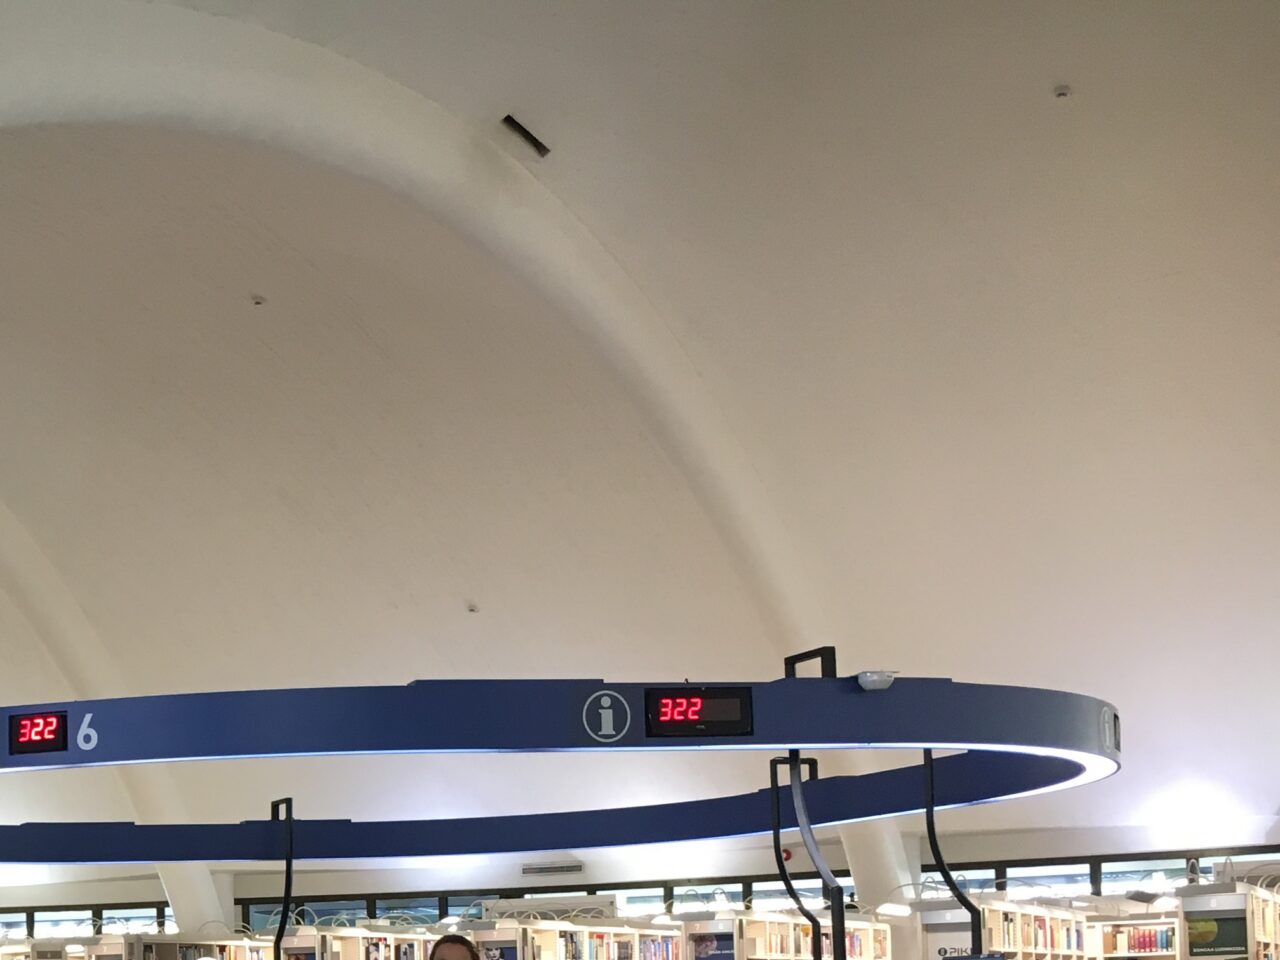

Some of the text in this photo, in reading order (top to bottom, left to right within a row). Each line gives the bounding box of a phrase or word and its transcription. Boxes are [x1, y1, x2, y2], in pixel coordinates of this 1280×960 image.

[658, 697, 704, 722] 322
[18, 715, 59, 743] 322
[76, 712, 99, 751] 6
